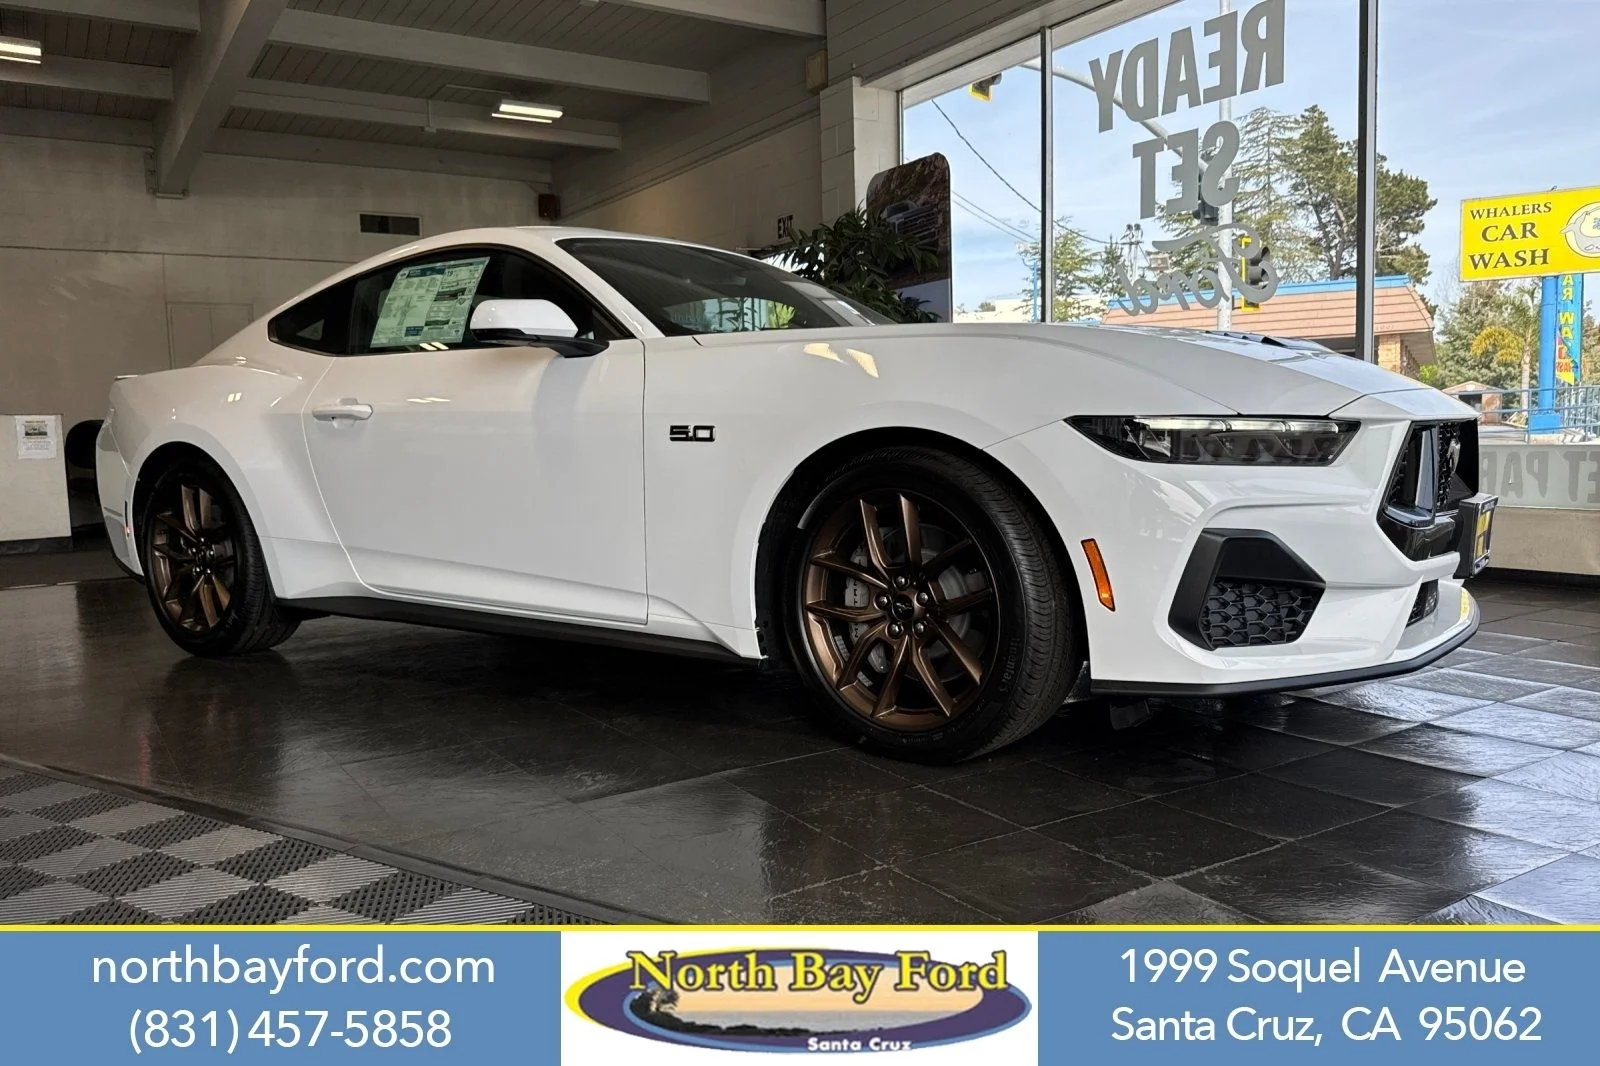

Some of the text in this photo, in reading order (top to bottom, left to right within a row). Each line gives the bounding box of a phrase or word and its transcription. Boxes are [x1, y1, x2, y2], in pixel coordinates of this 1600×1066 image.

[1470, 202, 1552, 220] WHALERS
[778, 214, 793, 239] EXIT
[1481, 222, 1539, 242] CAR
[1468, 248, 1549, 270] WASH
